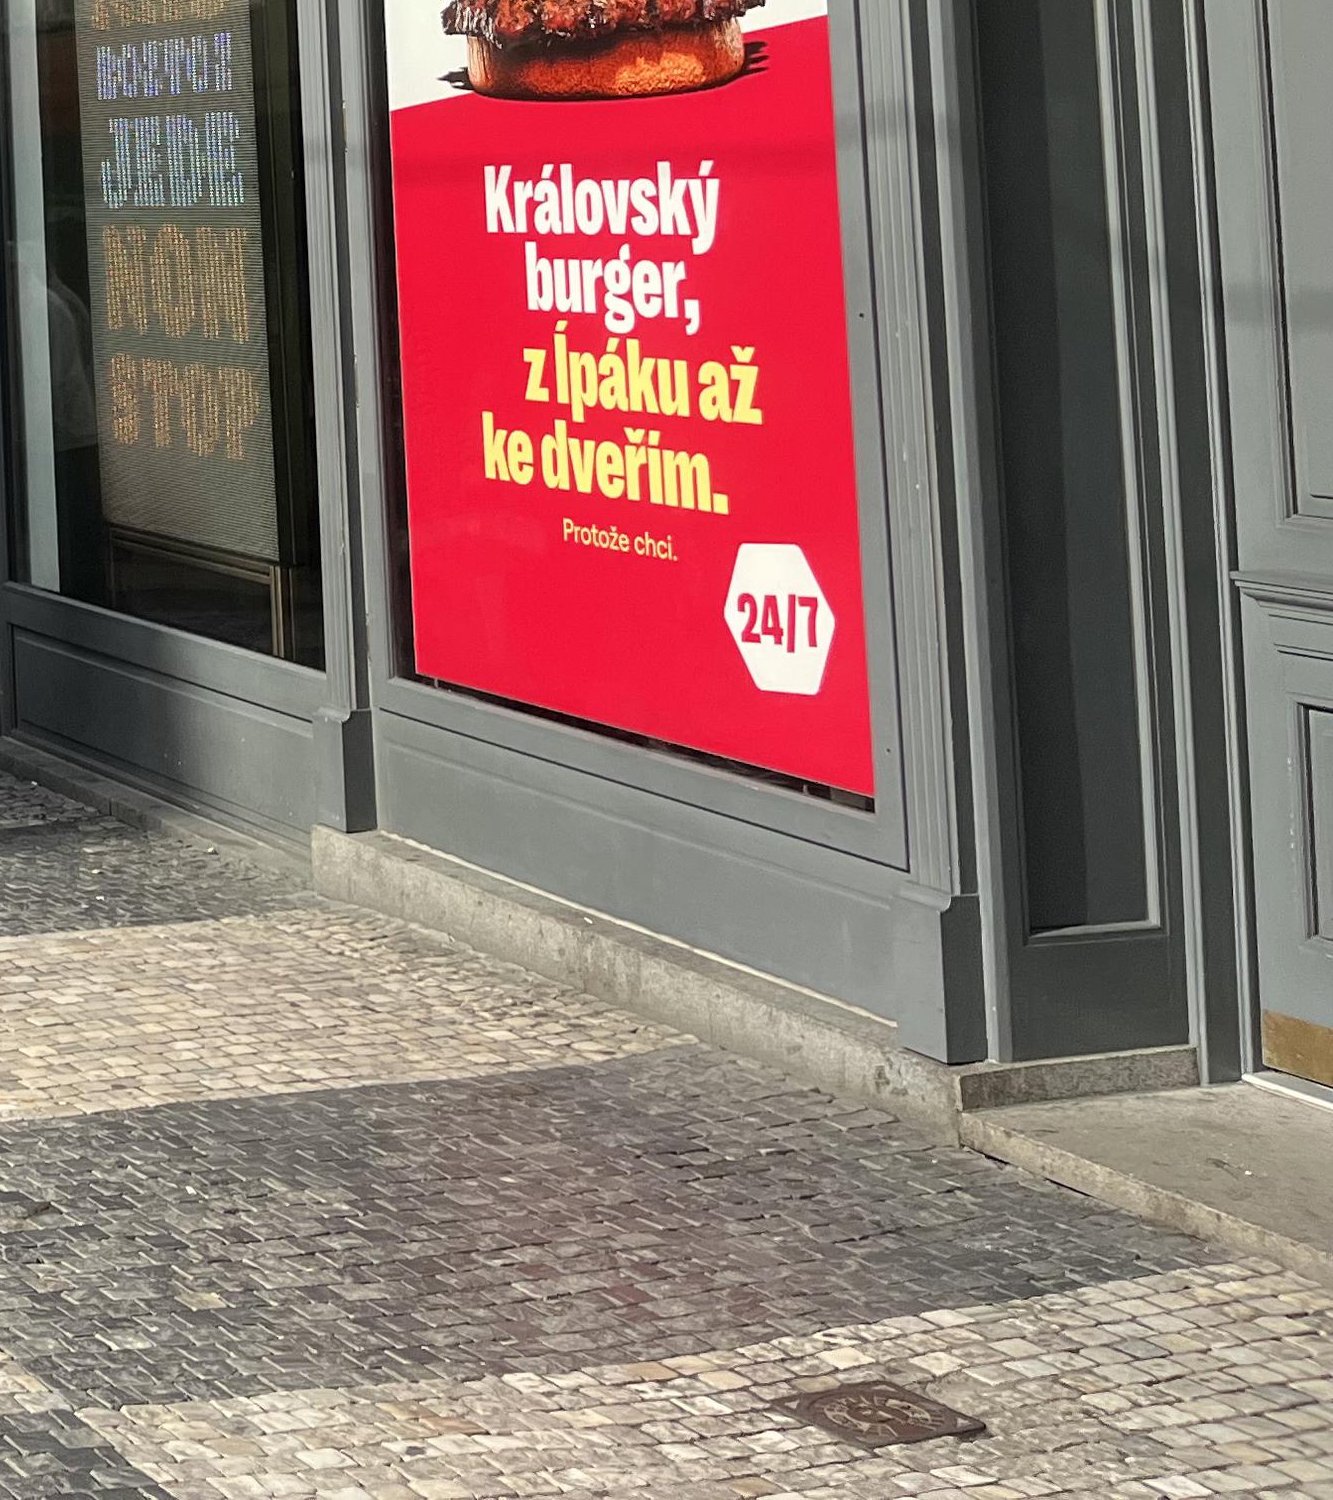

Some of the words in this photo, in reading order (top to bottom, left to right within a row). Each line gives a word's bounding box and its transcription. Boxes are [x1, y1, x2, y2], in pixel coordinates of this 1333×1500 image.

[101, 111, 244, 208] JEDE
[484, 159, 720, 255] Královský
[102, 223, 250, 344] NON
[524, 241, 701, 336] burger,
[111, 353, 261, 460] STOP
[523, 346, 550, 402] z
[697, 346, 763, 425] až
[481, 411, 534, 486] ke
[540, 418, 729, 515] dveřím.
[562, 517, 630, 554] Protože
[633, 530, 679, 562] chci.
[737, 592, 819, 653] 24/7
